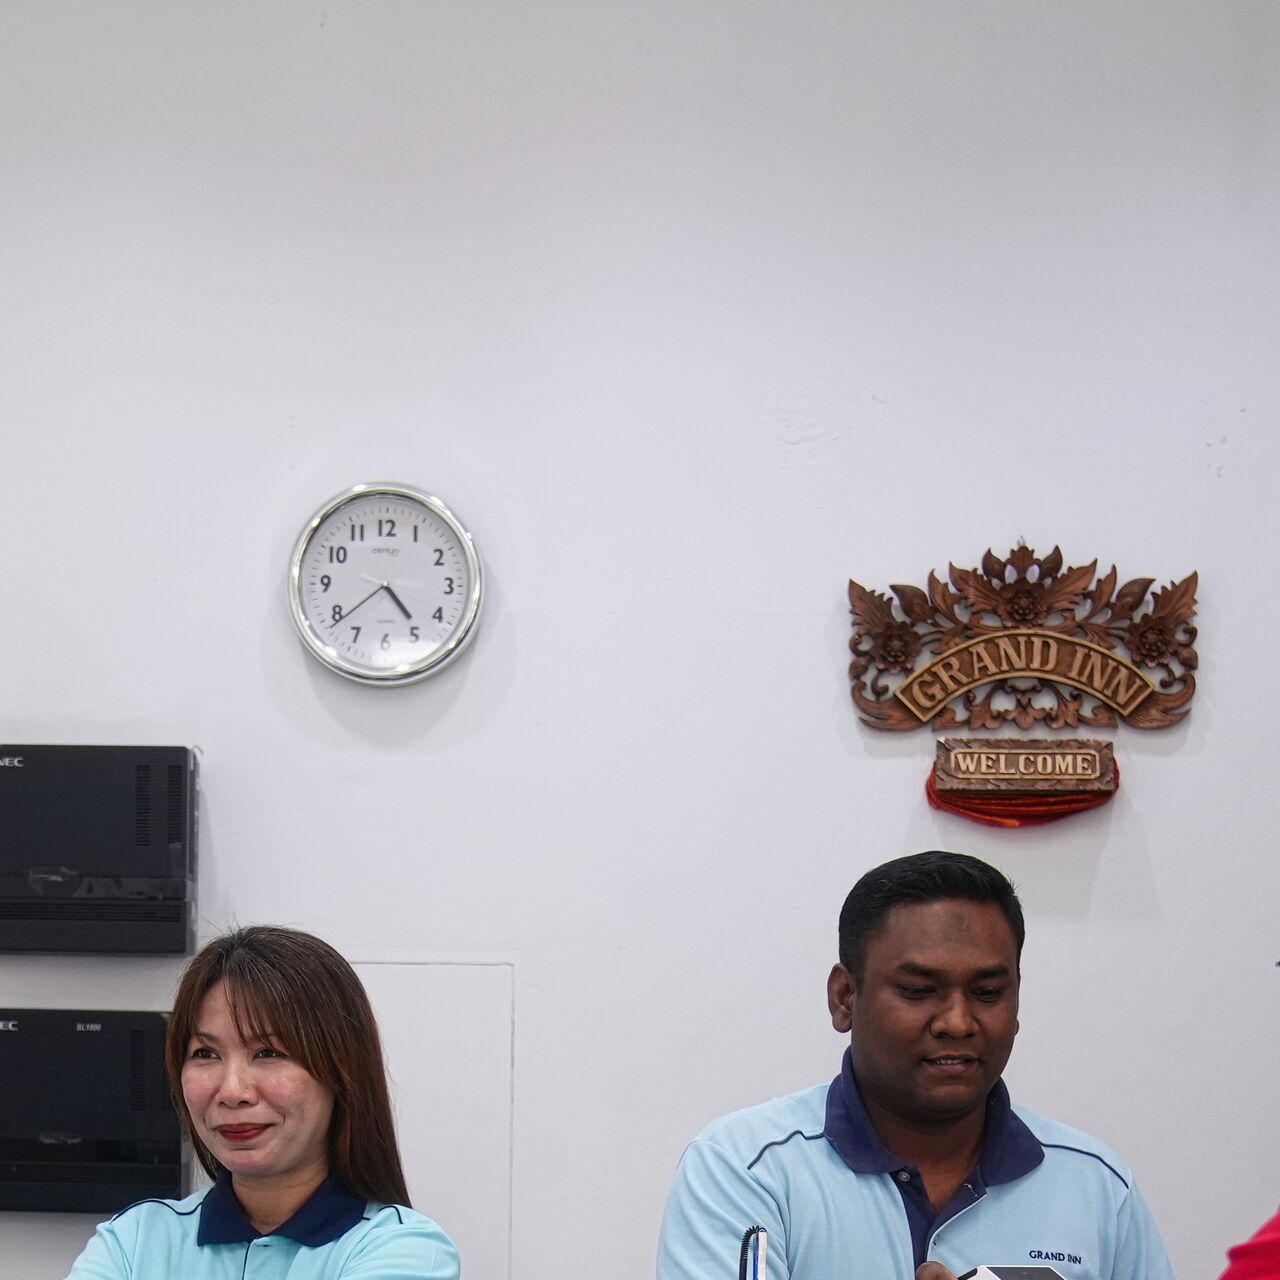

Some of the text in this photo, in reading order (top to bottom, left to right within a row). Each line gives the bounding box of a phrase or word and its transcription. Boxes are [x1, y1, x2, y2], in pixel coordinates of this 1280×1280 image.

[351, 524, 364, 541] 11
[378, 520, 397, 537] 12
[413, 525, 418, 542] 1
[329, 546, 347, 563] 10
[372, 547, 400, 556] century
[433, 549, 444, 566] 2
[320, 575, 331, 592] 9
[444, 578, 454, 594] 3
[332, 605, 342, 622] 8
[433, 607, 443, 623] 4
[351, 627, 361, 643] 7
[381, 634, 390, 650] 6
[409, 627, 419, 643] 5
[911, 636, 1144, 709] GRAND INN
[955, 753, 1093, 775] WELCOME
[1029, 1250, 1082, 1265] GRAND INN
